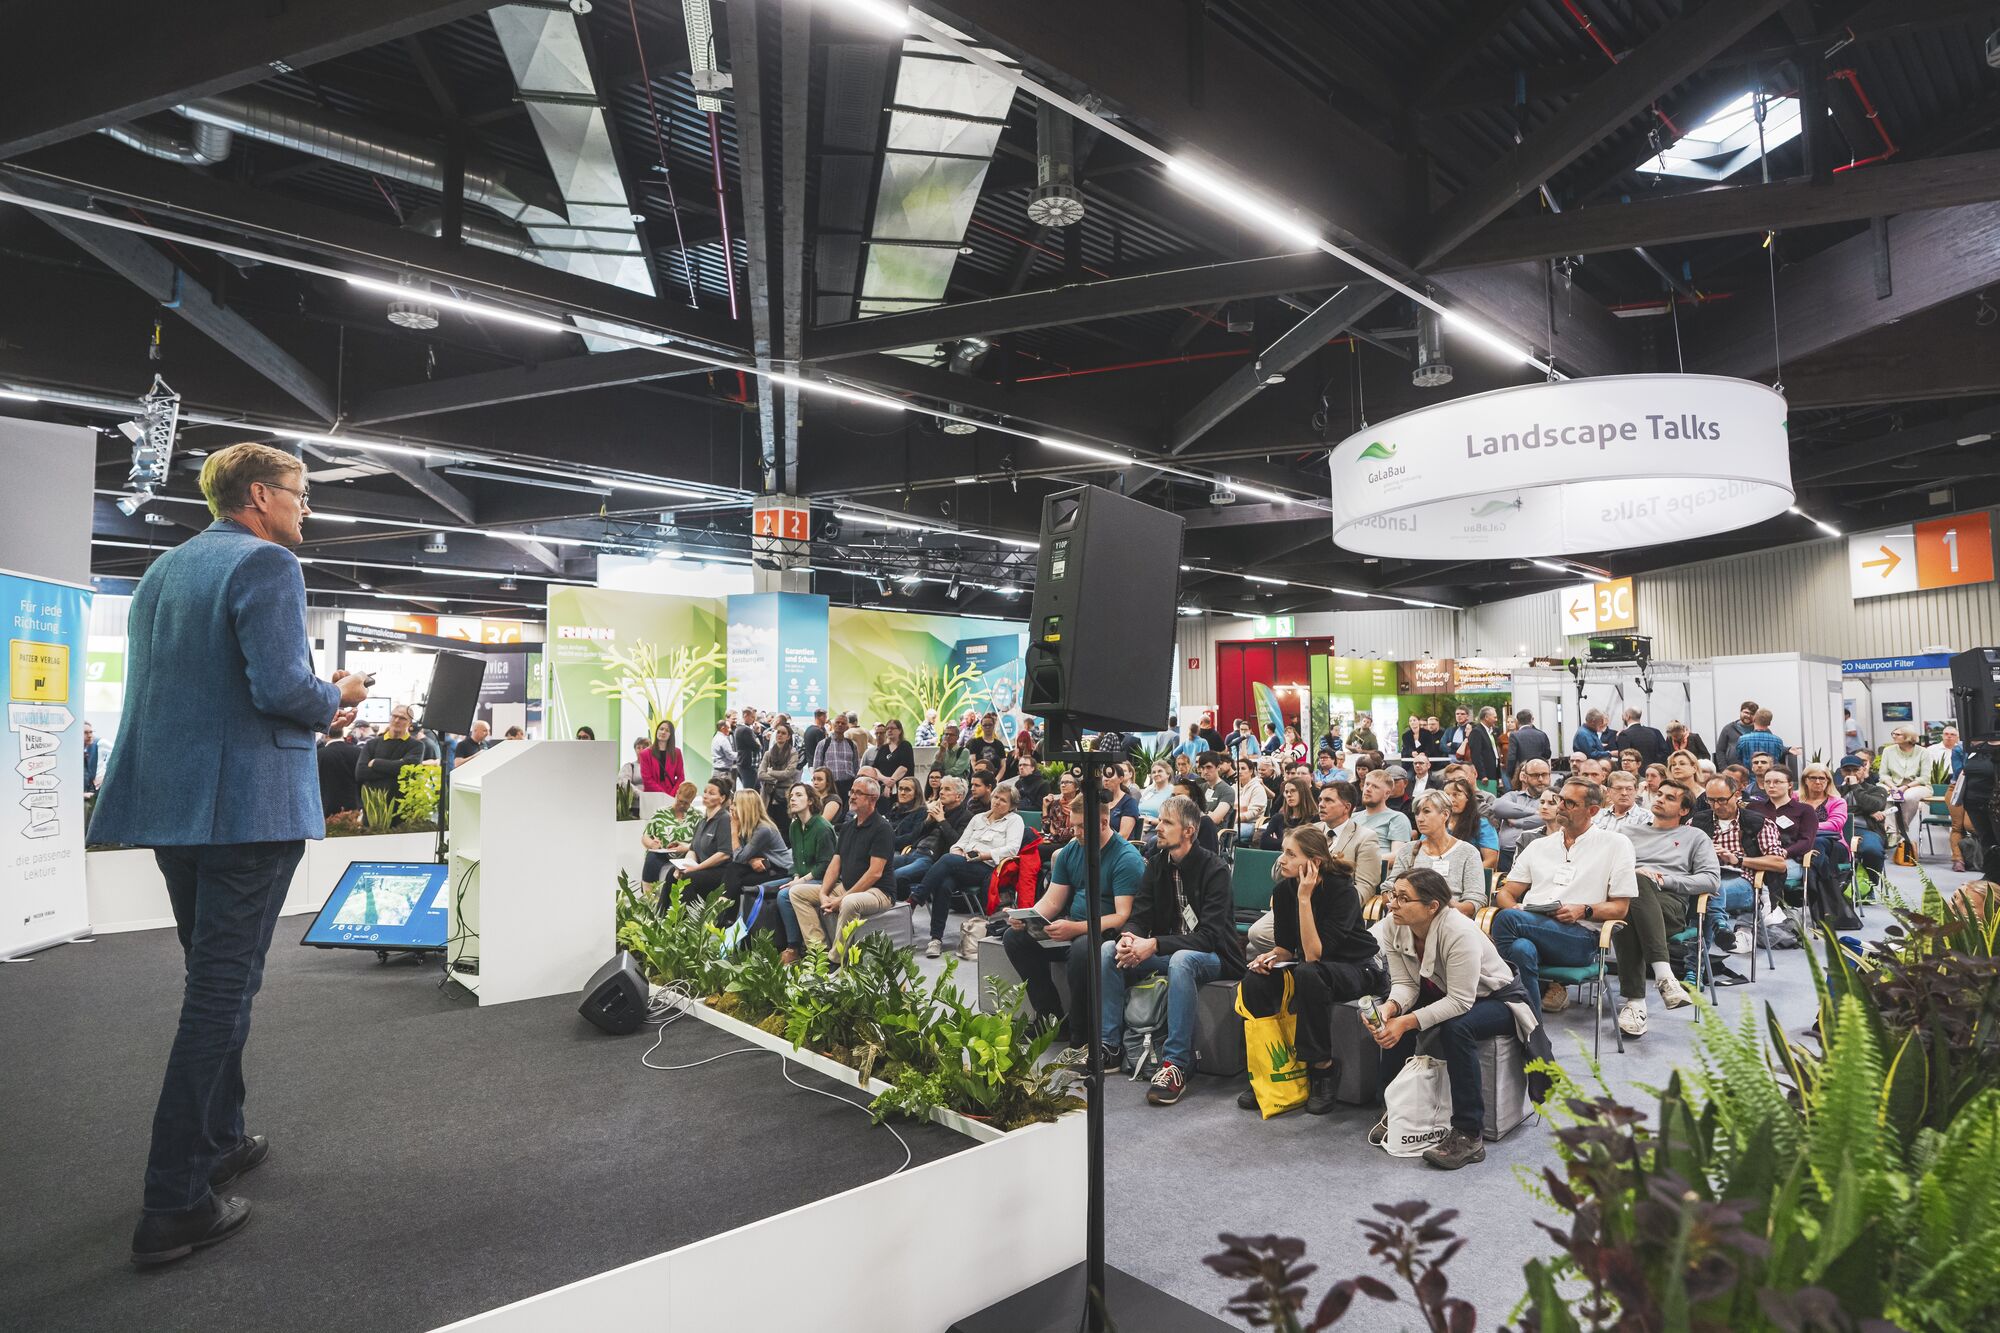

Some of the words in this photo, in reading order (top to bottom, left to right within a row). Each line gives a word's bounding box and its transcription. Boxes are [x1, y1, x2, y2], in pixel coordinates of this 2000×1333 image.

[1467, 422, 1637, 458] Landscape
[1646, 414, 1721, 441] Talks
[1368, 465, 1406, 484] GaLaBau
[791, 515, 801, 534] 2
[1942, 528, 1959, 573] 1
[20, 600, 37, 613] Für
[41, 603, 62, 617] jede
[1599, 587, 1630, 622] 3C
[14, 616, 59, 634] Richtung
[1855, 661, 1893, 671] Naturpool
[1894, 660, 1915, 668] Filter
[25, 734, 42, 743] NEUE
[16, 856, 30, 866] die
[32, 848, 71, 864] passende
[1401, 1128, 1446, 1145] saucony
